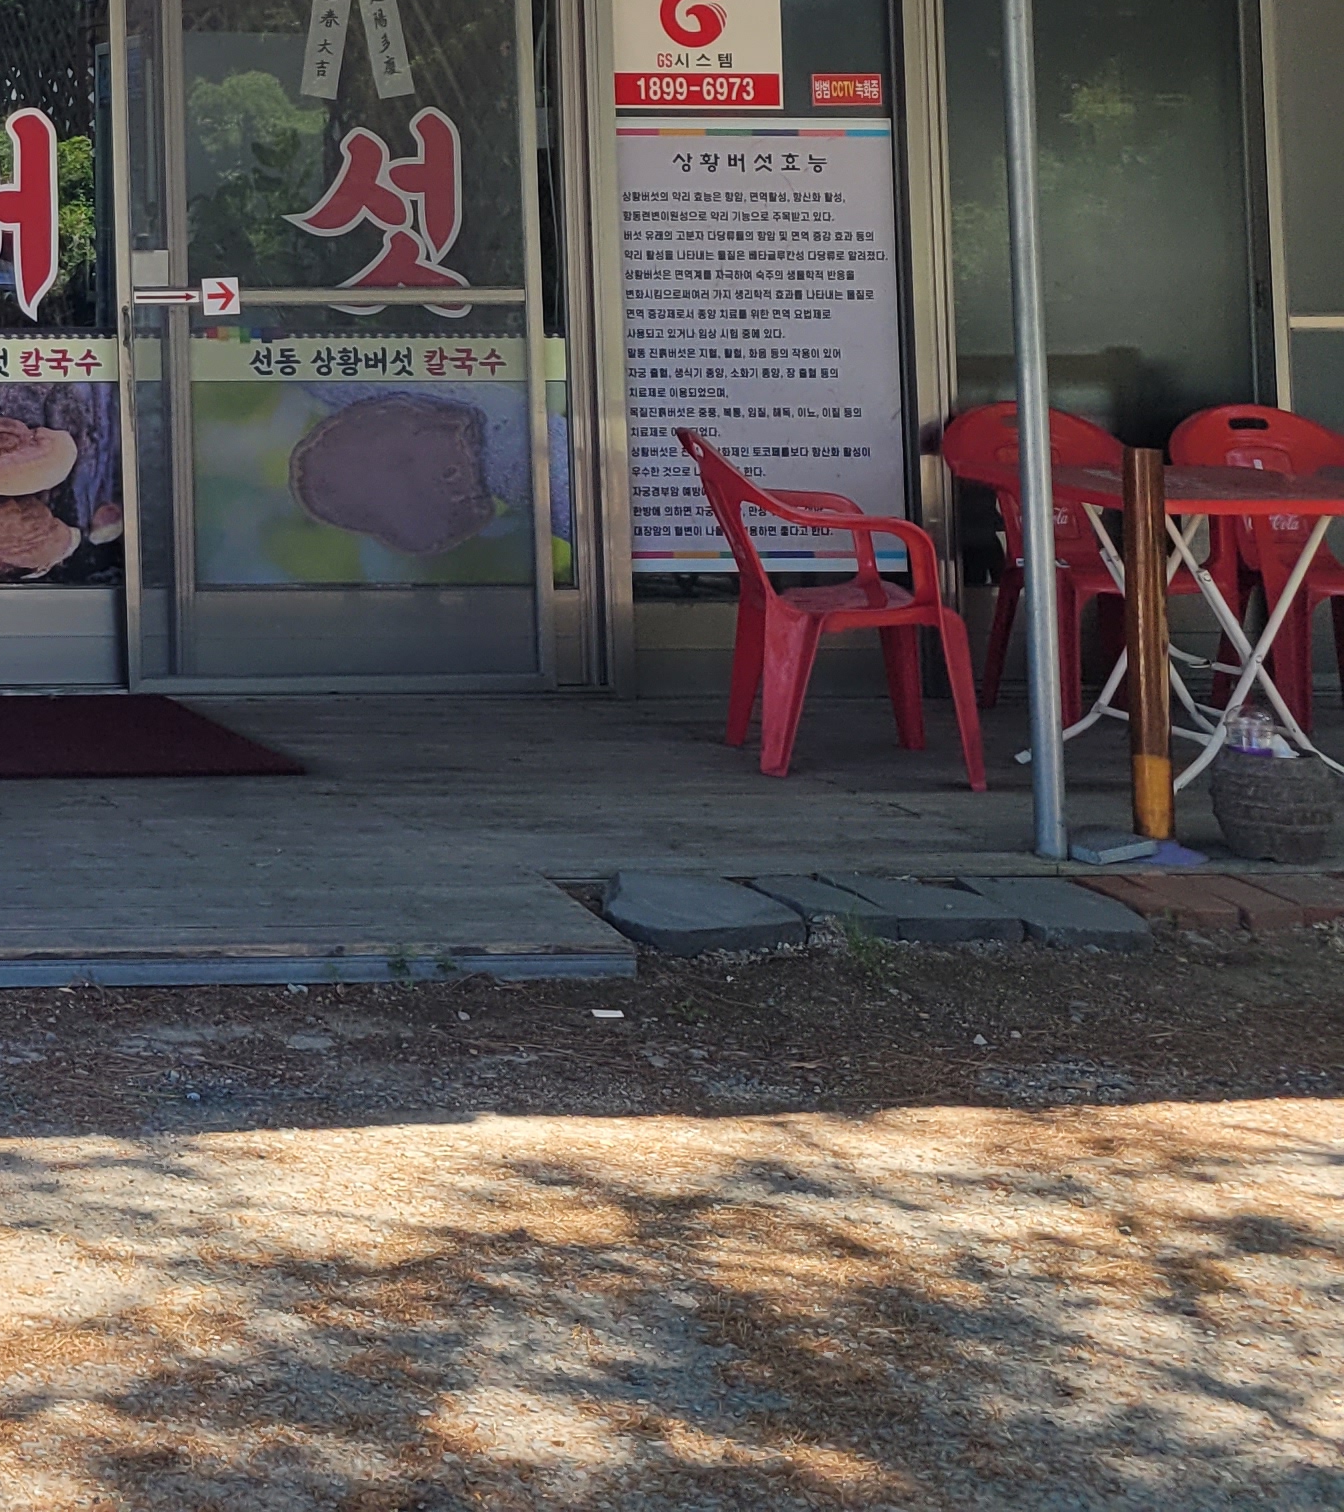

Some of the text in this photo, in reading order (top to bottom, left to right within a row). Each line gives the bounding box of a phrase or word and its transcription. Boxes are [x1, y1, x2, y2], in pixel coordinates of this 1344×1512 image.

[636, 77, 755, 101] 1899-6973
[814, 79, 879, 99] 방범 CCTV 녹화중
[622, 191, 669, 202] 상황버섯의
[672, 191, 691, 202] 약리
[693, 191, 722, 202] 효능은
[710, 211, 729, 222] 약리
[732, 211, 769, 222] 기능으로
[772, 211, 810, 222] 주목받고
[813, 211, 835, 222] 있다.
[623, 230, 642, 241] 버섯
[645, 230, 672, 241] 유래의
[675, 230, 704, 241] 고분자
[778, 230, 788, 241] 및
[791, 230, 810, 241] 면역
[834, 230, 853, 241] 효과
[856, 230, 874, 241] 등의
[624, 250, 643, 261] 약리
[676, 250, 714, 261] 나타내는
[807, 250, 845, 261] 다당류로
[624, 269, 672, 280] 상황버섯은
[715, 269, 752, 280] 자극하여
[713, 289, 731, 300] 가지
[734, 289, 772, 300] 생리학적
[806, 289, 843, 300] 나타내는
[846, 289, 874, 300] 물질로
[626, 309, 645, 319] 면역
[697, 309, 716, 319] 종양
[750, 309, 769, 319] 위한
[772, 309, 790, 319] 면역
[793, 309, 832, 319] 요법제로
[626, 328, 786, 339] 사용되고 있거나 임상 시험 중에 있다.
[770, 348, 789, 359] 등의
[792, 348, 820, 359] 작용이
[822, 348, 841, 359] 있어
[19, 347, 103, 377] 칼국수
[249, 346, 508, 377] 선동 상황버섯 칼국수
[628, 368, 646, 379] 자궁
[674, 368, 702, 379] 생식기
[730, 368, 758, 379] 소화기
[786, 368, 796, 379] 장
[820, 368, 839, 379] 등의
[629, 387, 729, 398] 치료제로 이용되었으며,
[843, 407, 862, 418] 등의
[630, 426, 668, 437] 치료제로
[631, 446, 678, 457] 상황버섯은
[812, 446, 840, 457] 항산화
[631, 466, 660, 477] 우수한
[662, 466, 691, 477] 것으로
[633, 506, 661, 517] 한방에
[664, 506, 692, 517] 의하면
[634, 526, 671, 537] 대장암의
[744, 526, 777, 537] 용하면
[811, 526, 833, 537] 한다.
